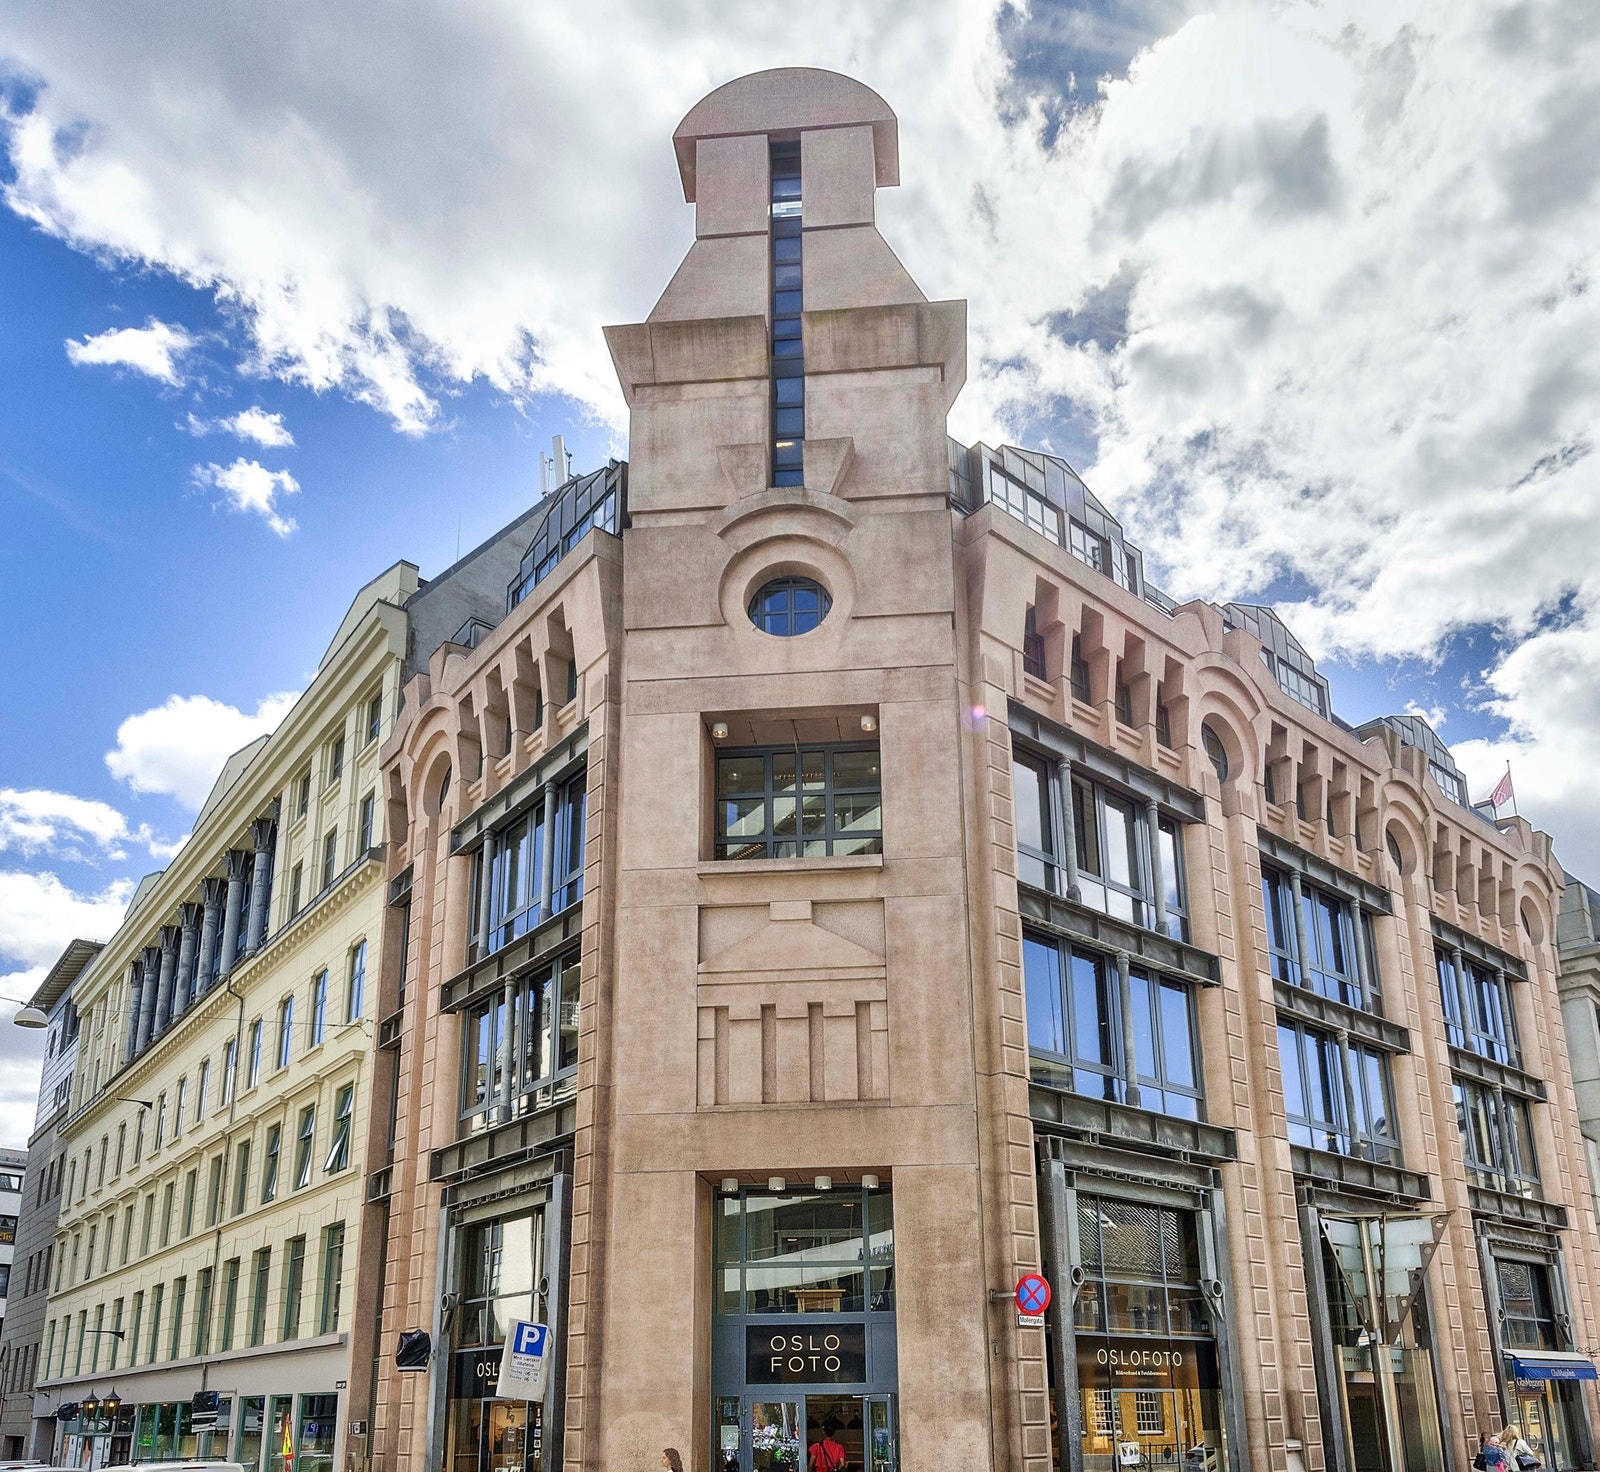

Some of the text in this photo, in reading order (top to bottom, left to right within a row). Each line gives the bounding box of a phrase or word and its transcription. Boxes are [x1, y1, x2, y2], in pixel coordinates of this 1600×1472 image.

[519, 1325, 540, 1352] P
[770, 1334, 840, 1352] OSLO
[770, 1355, 841, 1373] FOTO
[1096, 1348, 1183, 1367] OSLOFOTO
[476, 1361, 502, 1378] OSL
